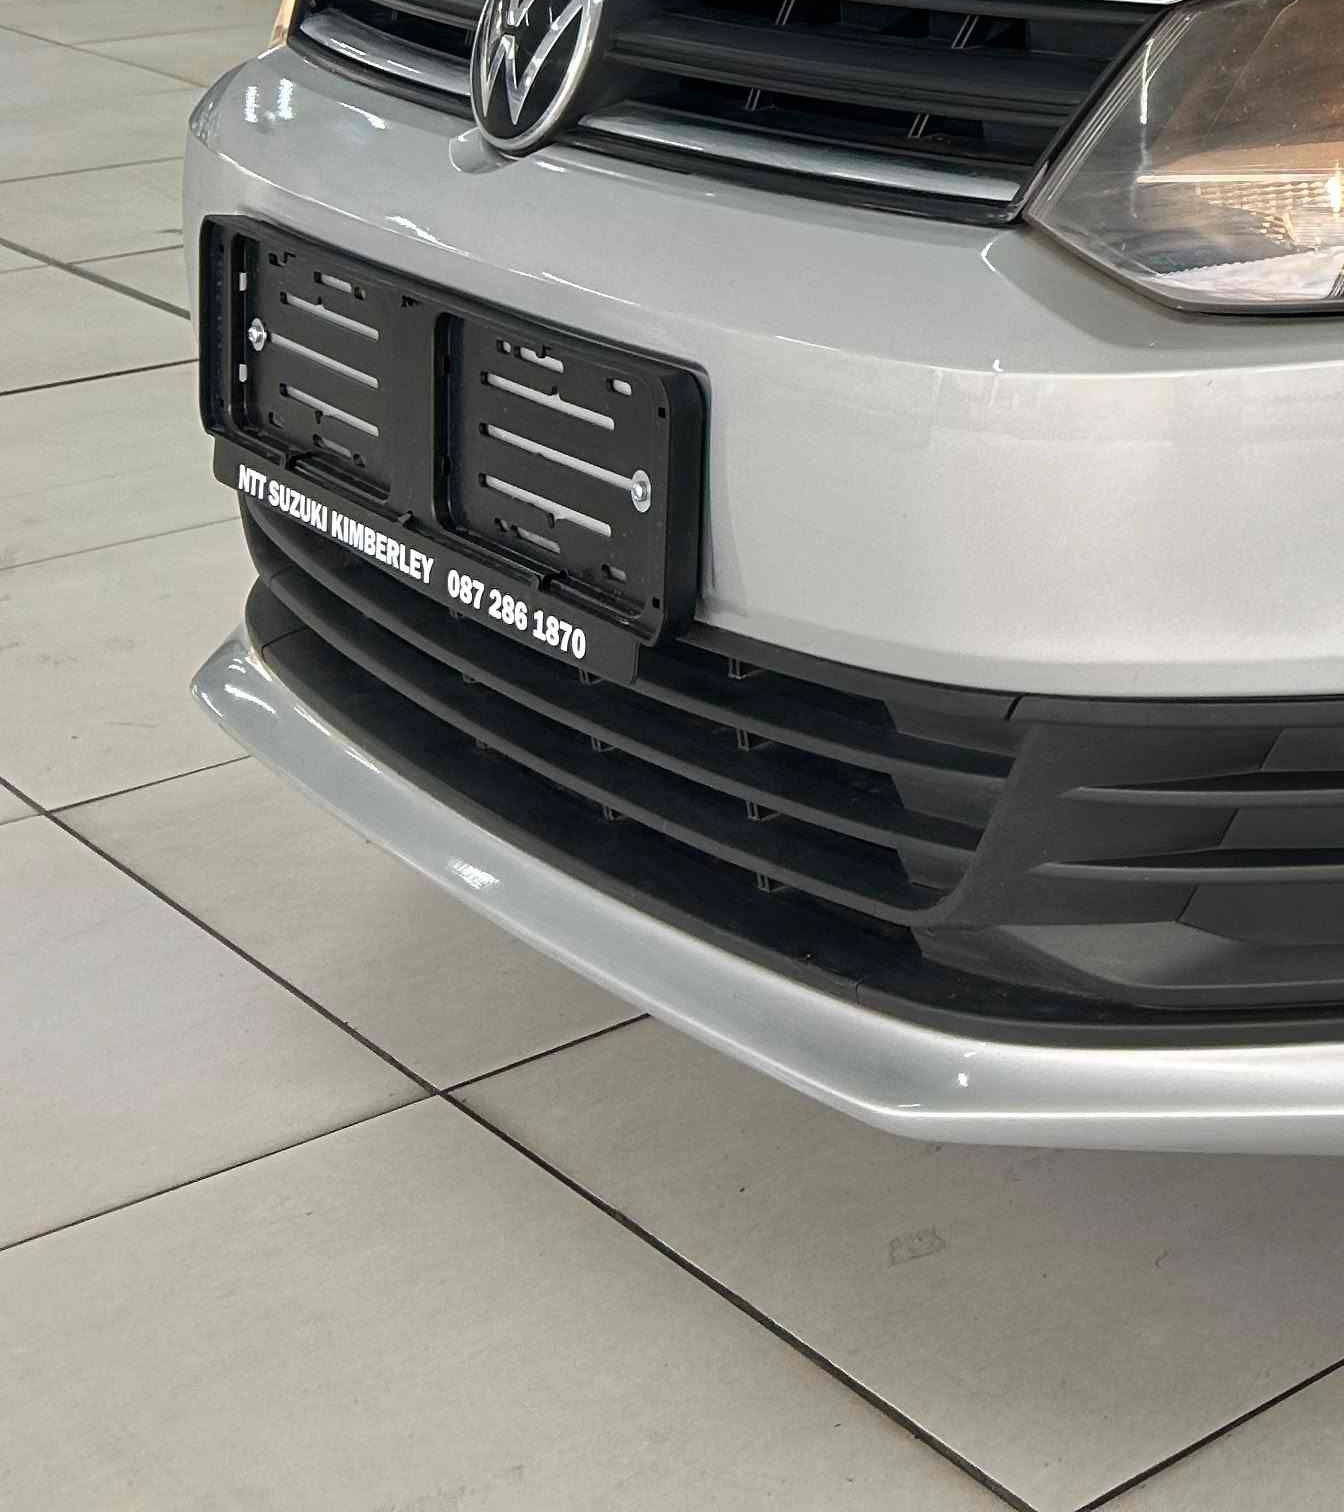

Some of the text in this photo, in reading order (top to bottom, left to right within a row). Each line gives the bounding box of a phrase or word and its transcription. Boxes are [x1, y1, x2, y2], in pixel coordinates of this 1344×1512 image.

[238, 464, 586, 659] NTT SUZUKI KIMBERLEY 087 286 1870
